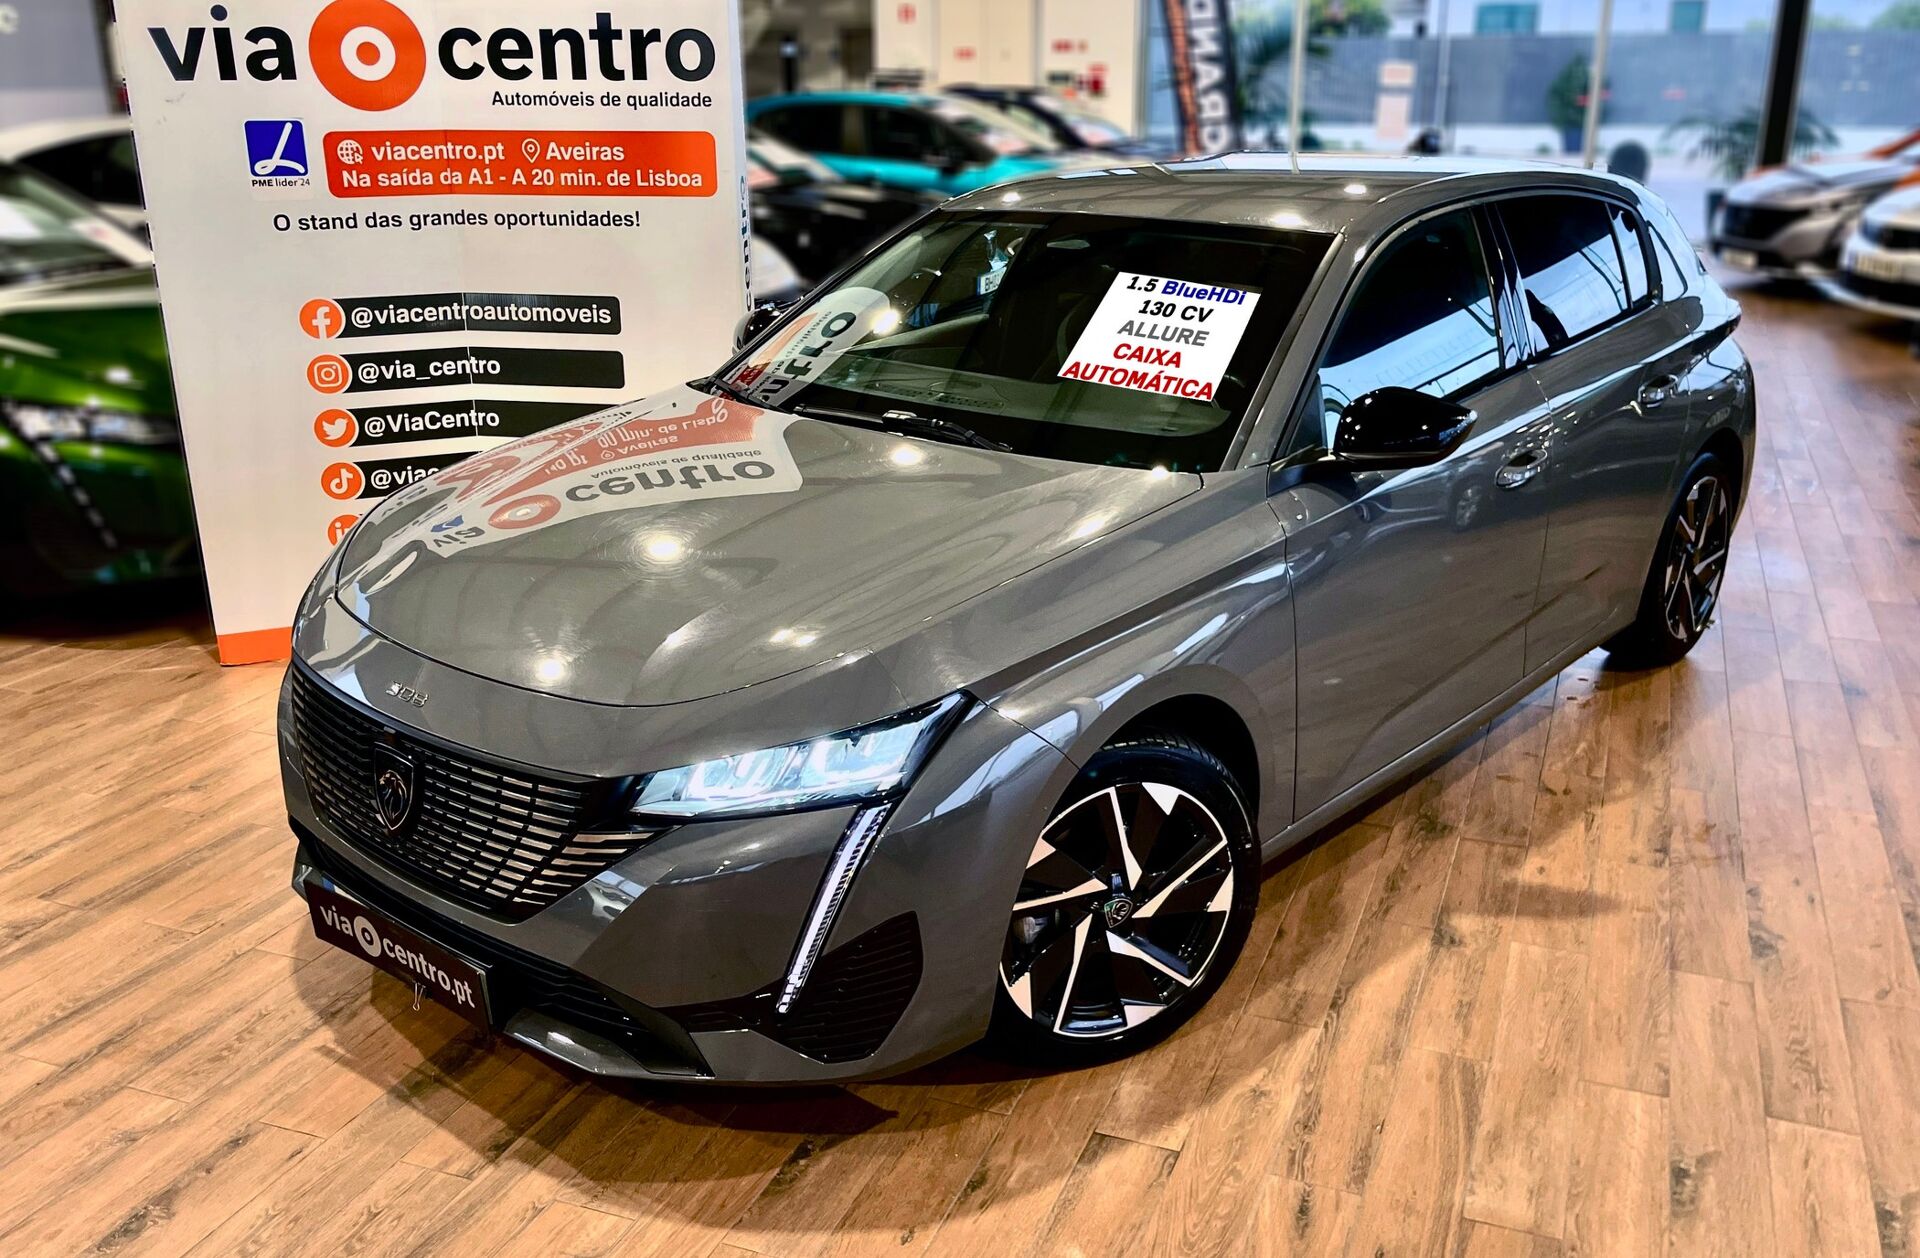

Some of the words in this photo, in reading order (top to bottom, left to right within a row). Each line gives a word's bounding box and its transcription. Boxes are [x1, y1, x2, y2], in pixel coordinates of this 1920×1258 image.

[438, 12, 716, 82] centro
[492, 90, 595, 107] Automóveis
[600, 91, 621, 107] de
[626, 92, 713, 111] qualidade
[371, 141, 505, 164] viacentro.pt
[545, 141, 625, 162] Aveiras
[251, 179, 273, 188] PME
[342, 170, 371, 188] Na
[378, 168, 434, 187] saída
[439, 168, 463, 186] da
[468, 168, 494, 186] A1
[511, 168, 527, 186] A
[531, 168, 554, 187] 20
[559, 168, 602, 187] min.
[607, 169, 631, 187] de
[636, 169, 702, 188] Lisboa
[273, 213, 291, 232] O
[298, 212, 358, 231] stand
[365, 211, 403, 229] das
[409, 209, 488, 231] grandes
[494, 209, 641, 229] oportunidades!
[351, 301, 612, 329] @viacentroautomoveis
[357, 355, 501, 385] @via_centro
[364, 409, 500, 438] @ViaCentro
[385, 681, 430, 708] 308
[382, 937, 476, 1009] centro.pt
